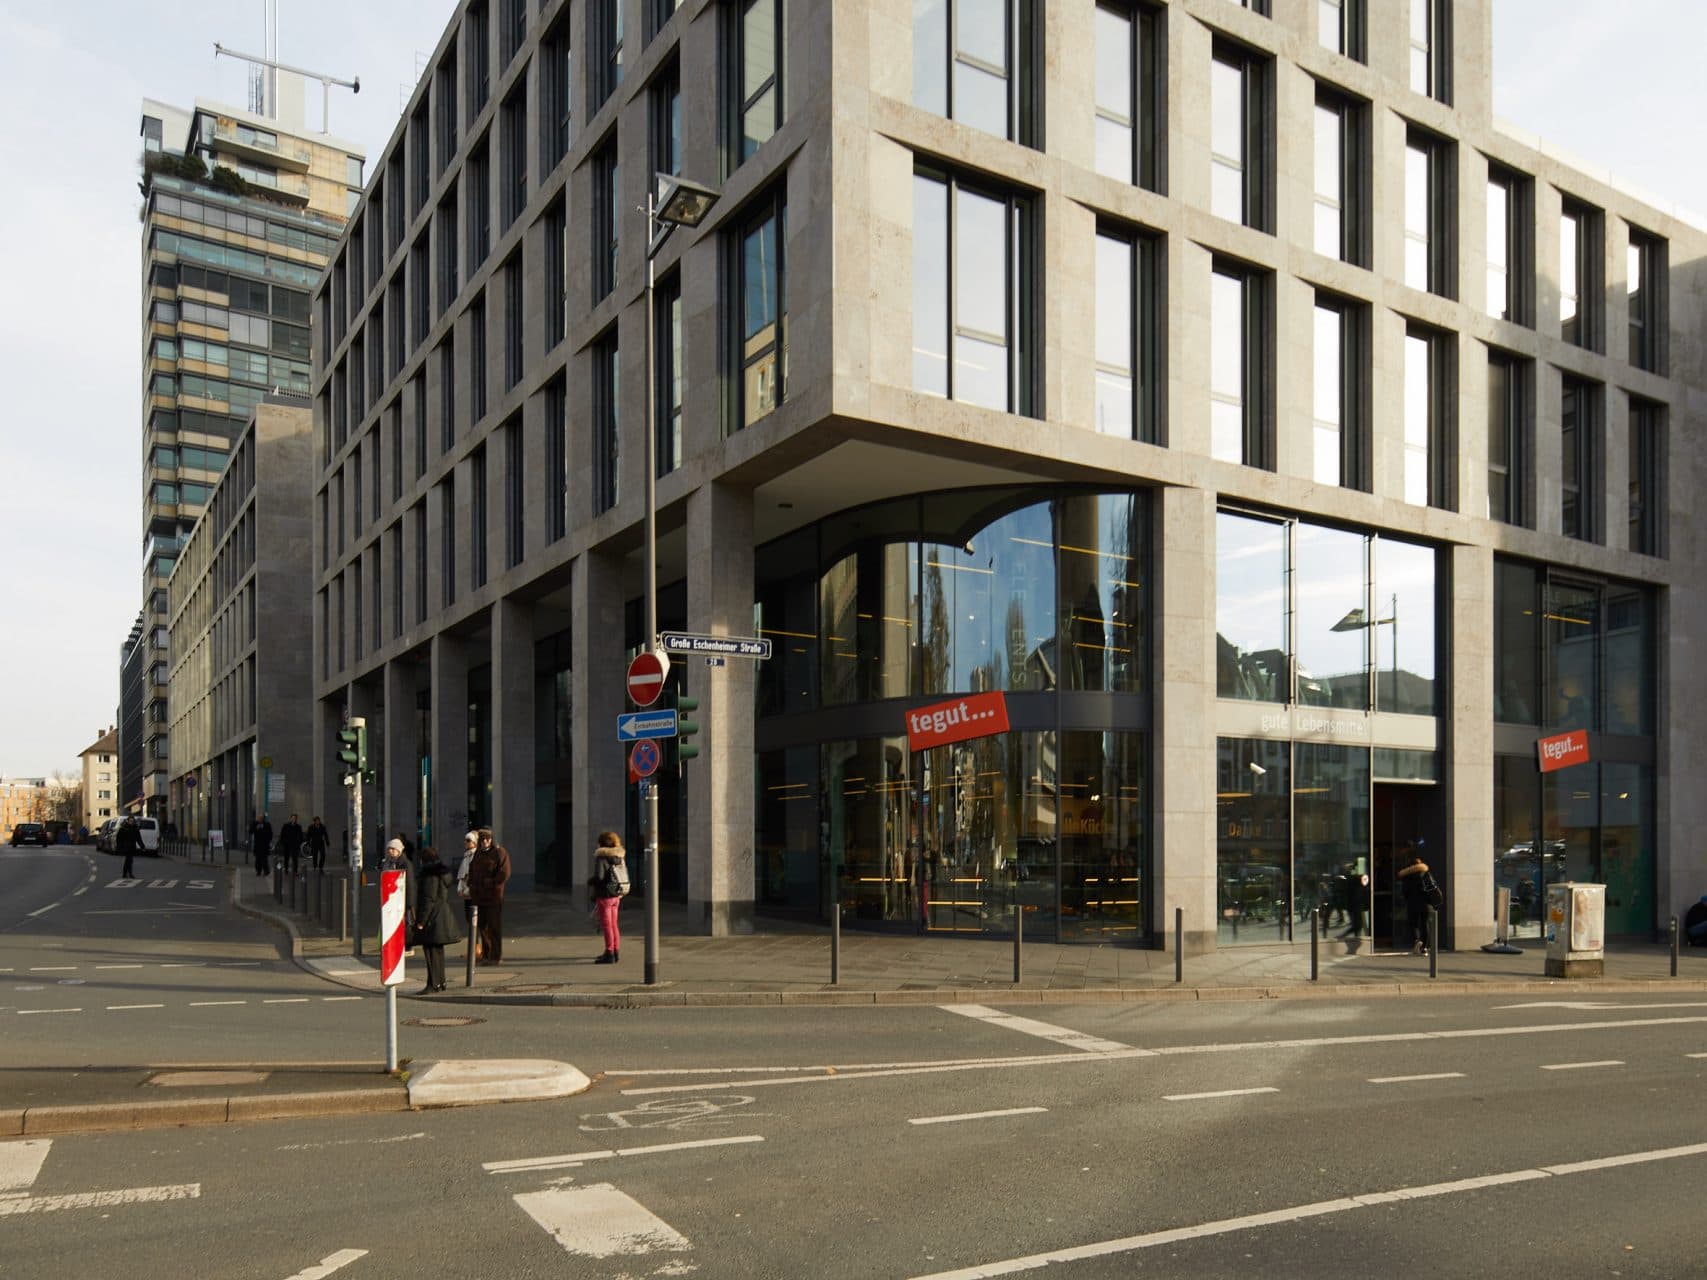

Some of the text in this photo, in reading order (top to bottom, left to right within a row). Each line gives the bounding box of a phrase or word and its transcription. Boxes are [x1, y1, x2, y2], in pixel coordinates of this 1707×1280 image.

[670, 637, 762, 654] Große Eschenheimer Straße
[911, 701, 995, 734] tegut...
[1262, 714, 1289, 732] gute
[1543, 735, 1584, 759] tegut...
[103, 879, 216, 889] BUS
